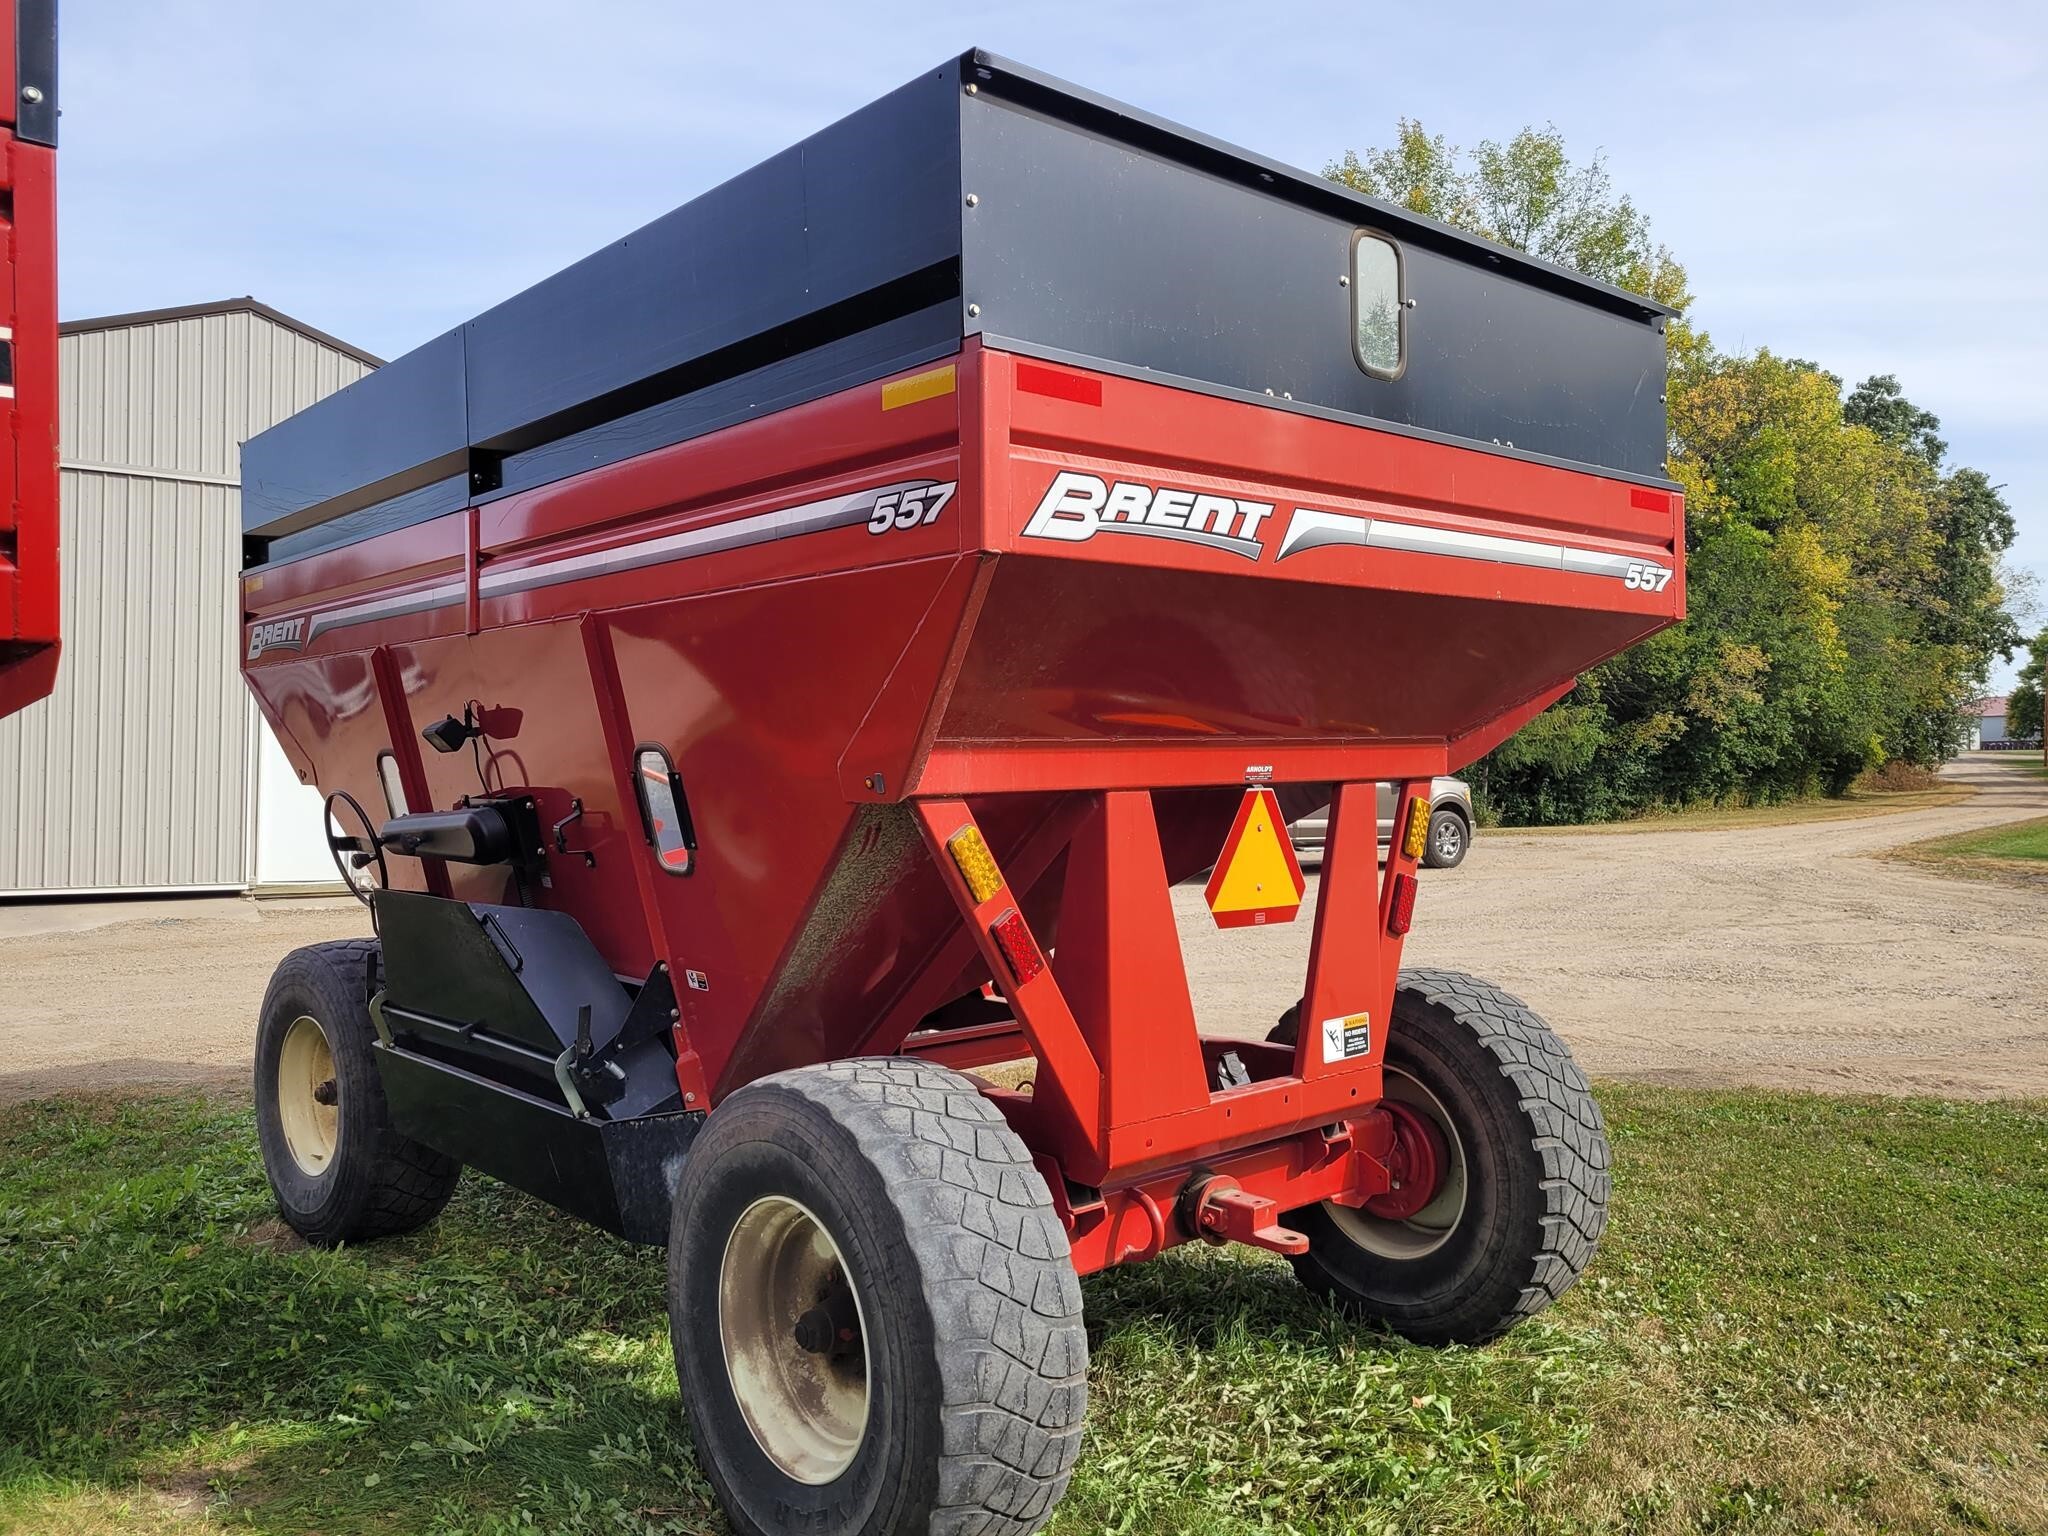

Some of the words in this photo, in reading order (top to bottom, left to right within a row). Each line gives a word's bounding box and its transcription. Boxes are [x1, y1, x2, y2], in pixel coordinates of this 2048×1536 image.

[867, 481, 958, 535] 557
[1020, 470, 1277, 543] BRENT
[1624, 563, 1673, 592] 557
[247, 617, 306, 661] BRENT
